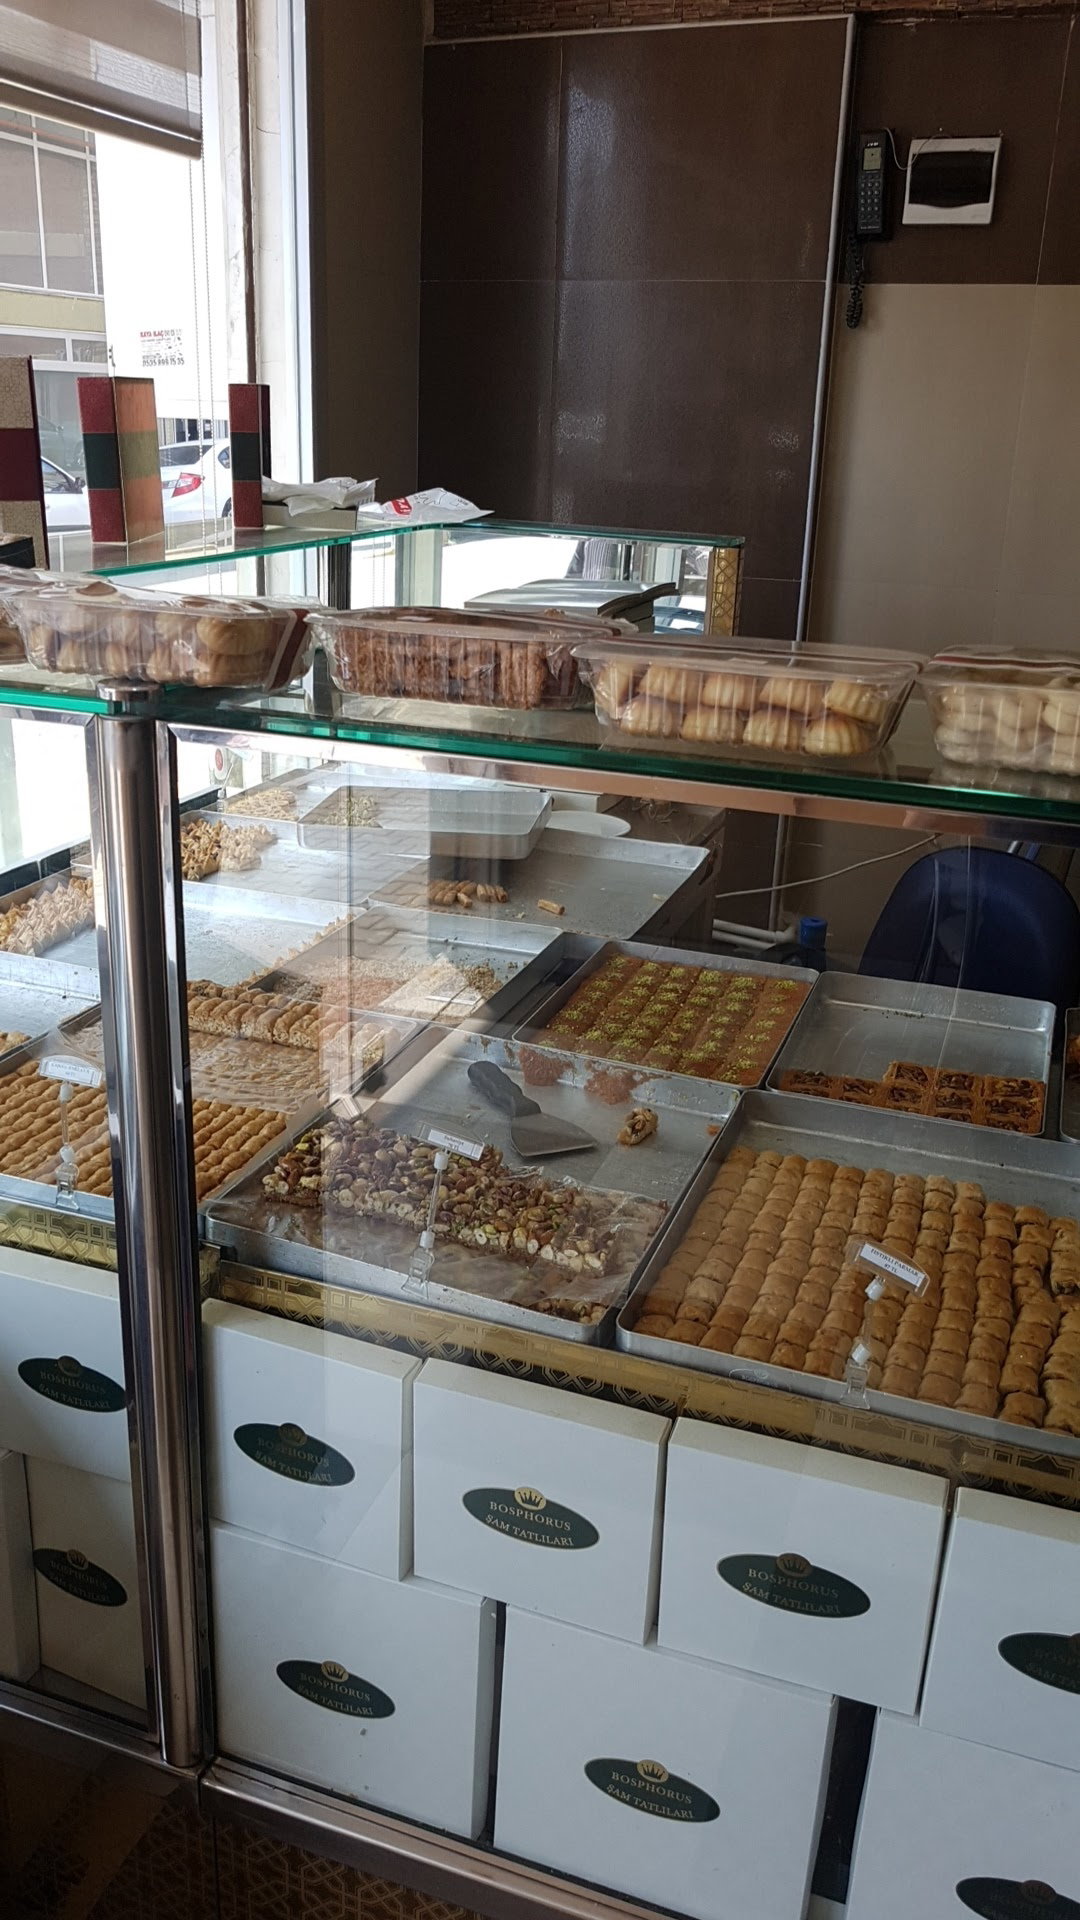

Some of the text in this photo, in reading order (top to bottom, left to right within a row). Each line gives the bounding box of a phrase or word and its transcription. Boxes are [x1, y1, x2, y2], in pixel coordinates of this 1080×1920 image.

[40, 1371, 107, 1394] BOSPHORUS
[257, 1437, 330, 1468] BOSPHORUS
[490, 1501, 571, 1531] BOSPHORUS
[512, 1526, 574, 1546] TATLILARI
[748, 1568, 840, 1599] BOSPHORUS
[772, 1593, 841, 1614] TATLILARI
[300, 1672, 371, 1702] BOSPHORUS
[611, 1771, 693, 1804] BOSPHORUS
[633, 1796, 694, 1819] TATLILARI
